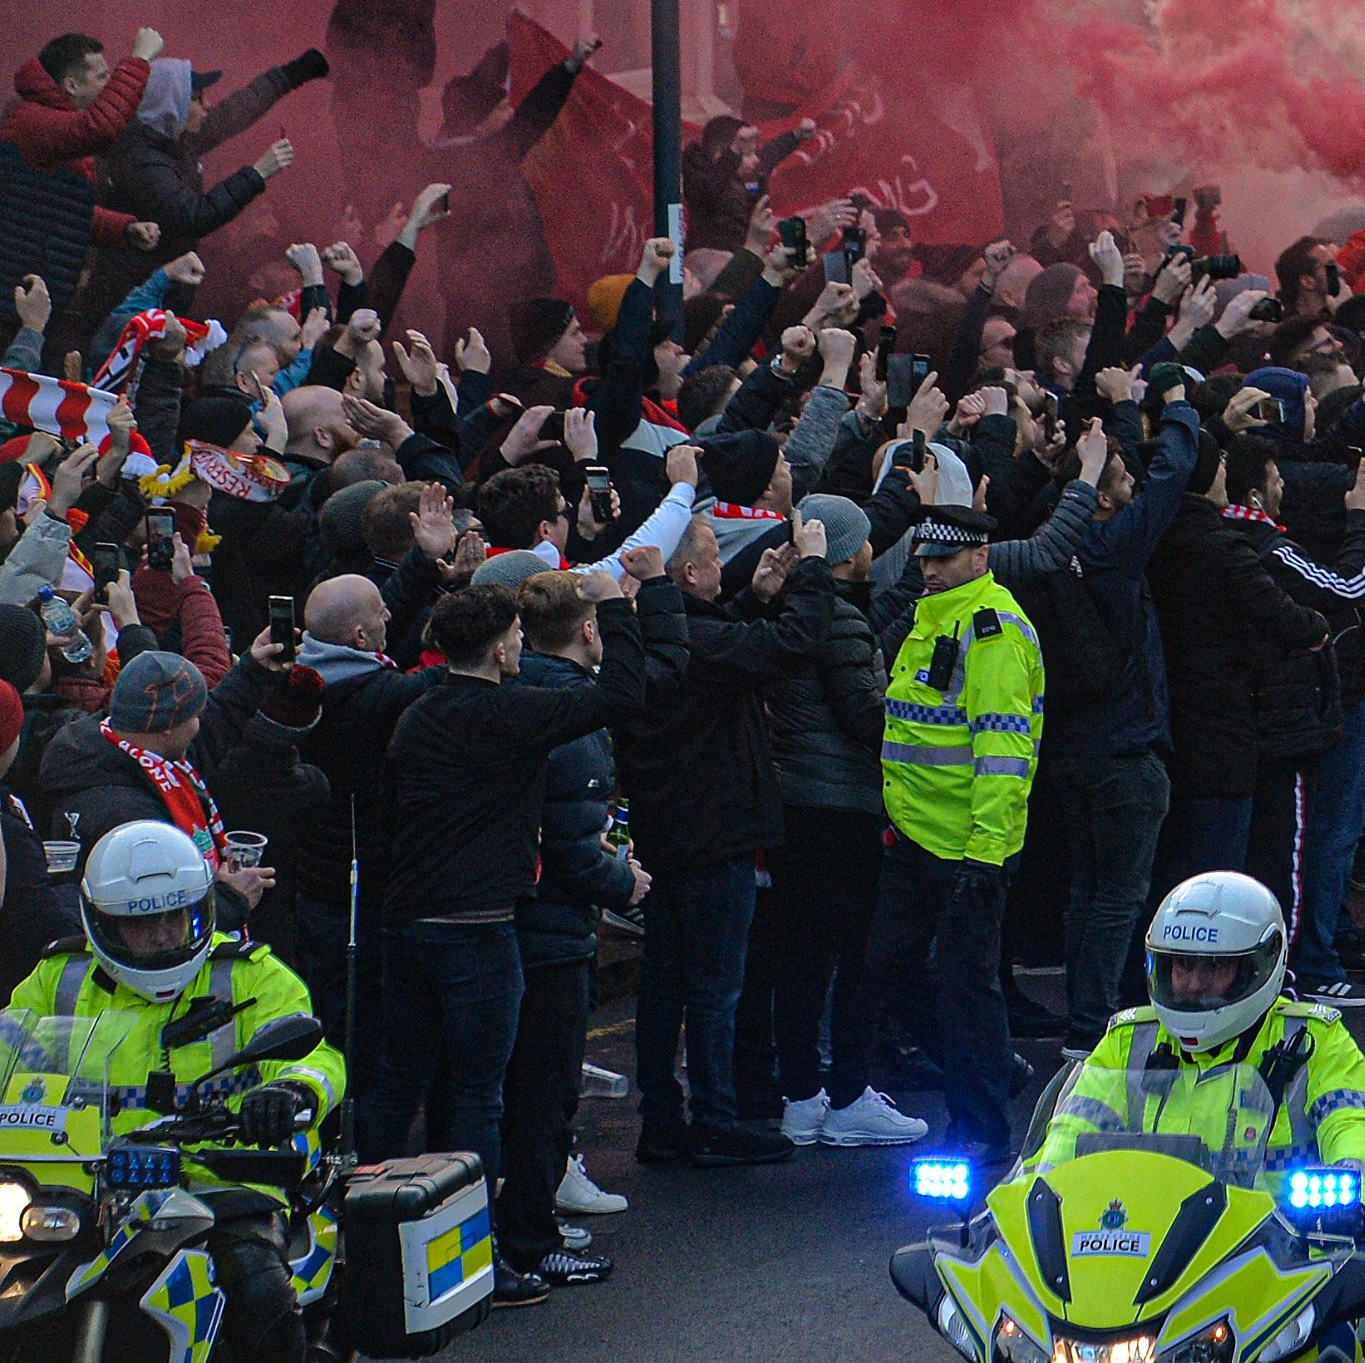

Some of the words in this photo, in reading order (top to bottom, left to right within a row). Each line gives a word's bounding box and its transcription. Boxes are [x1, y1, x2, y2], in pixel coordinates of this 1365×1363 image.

[127, 889, 187, 914] POLICE
[1163, 925, 1218, 943] POLICE
[0, 1112, 56, 1127] POLICE
[1079, 1239, 1140, 1252] POLICE
